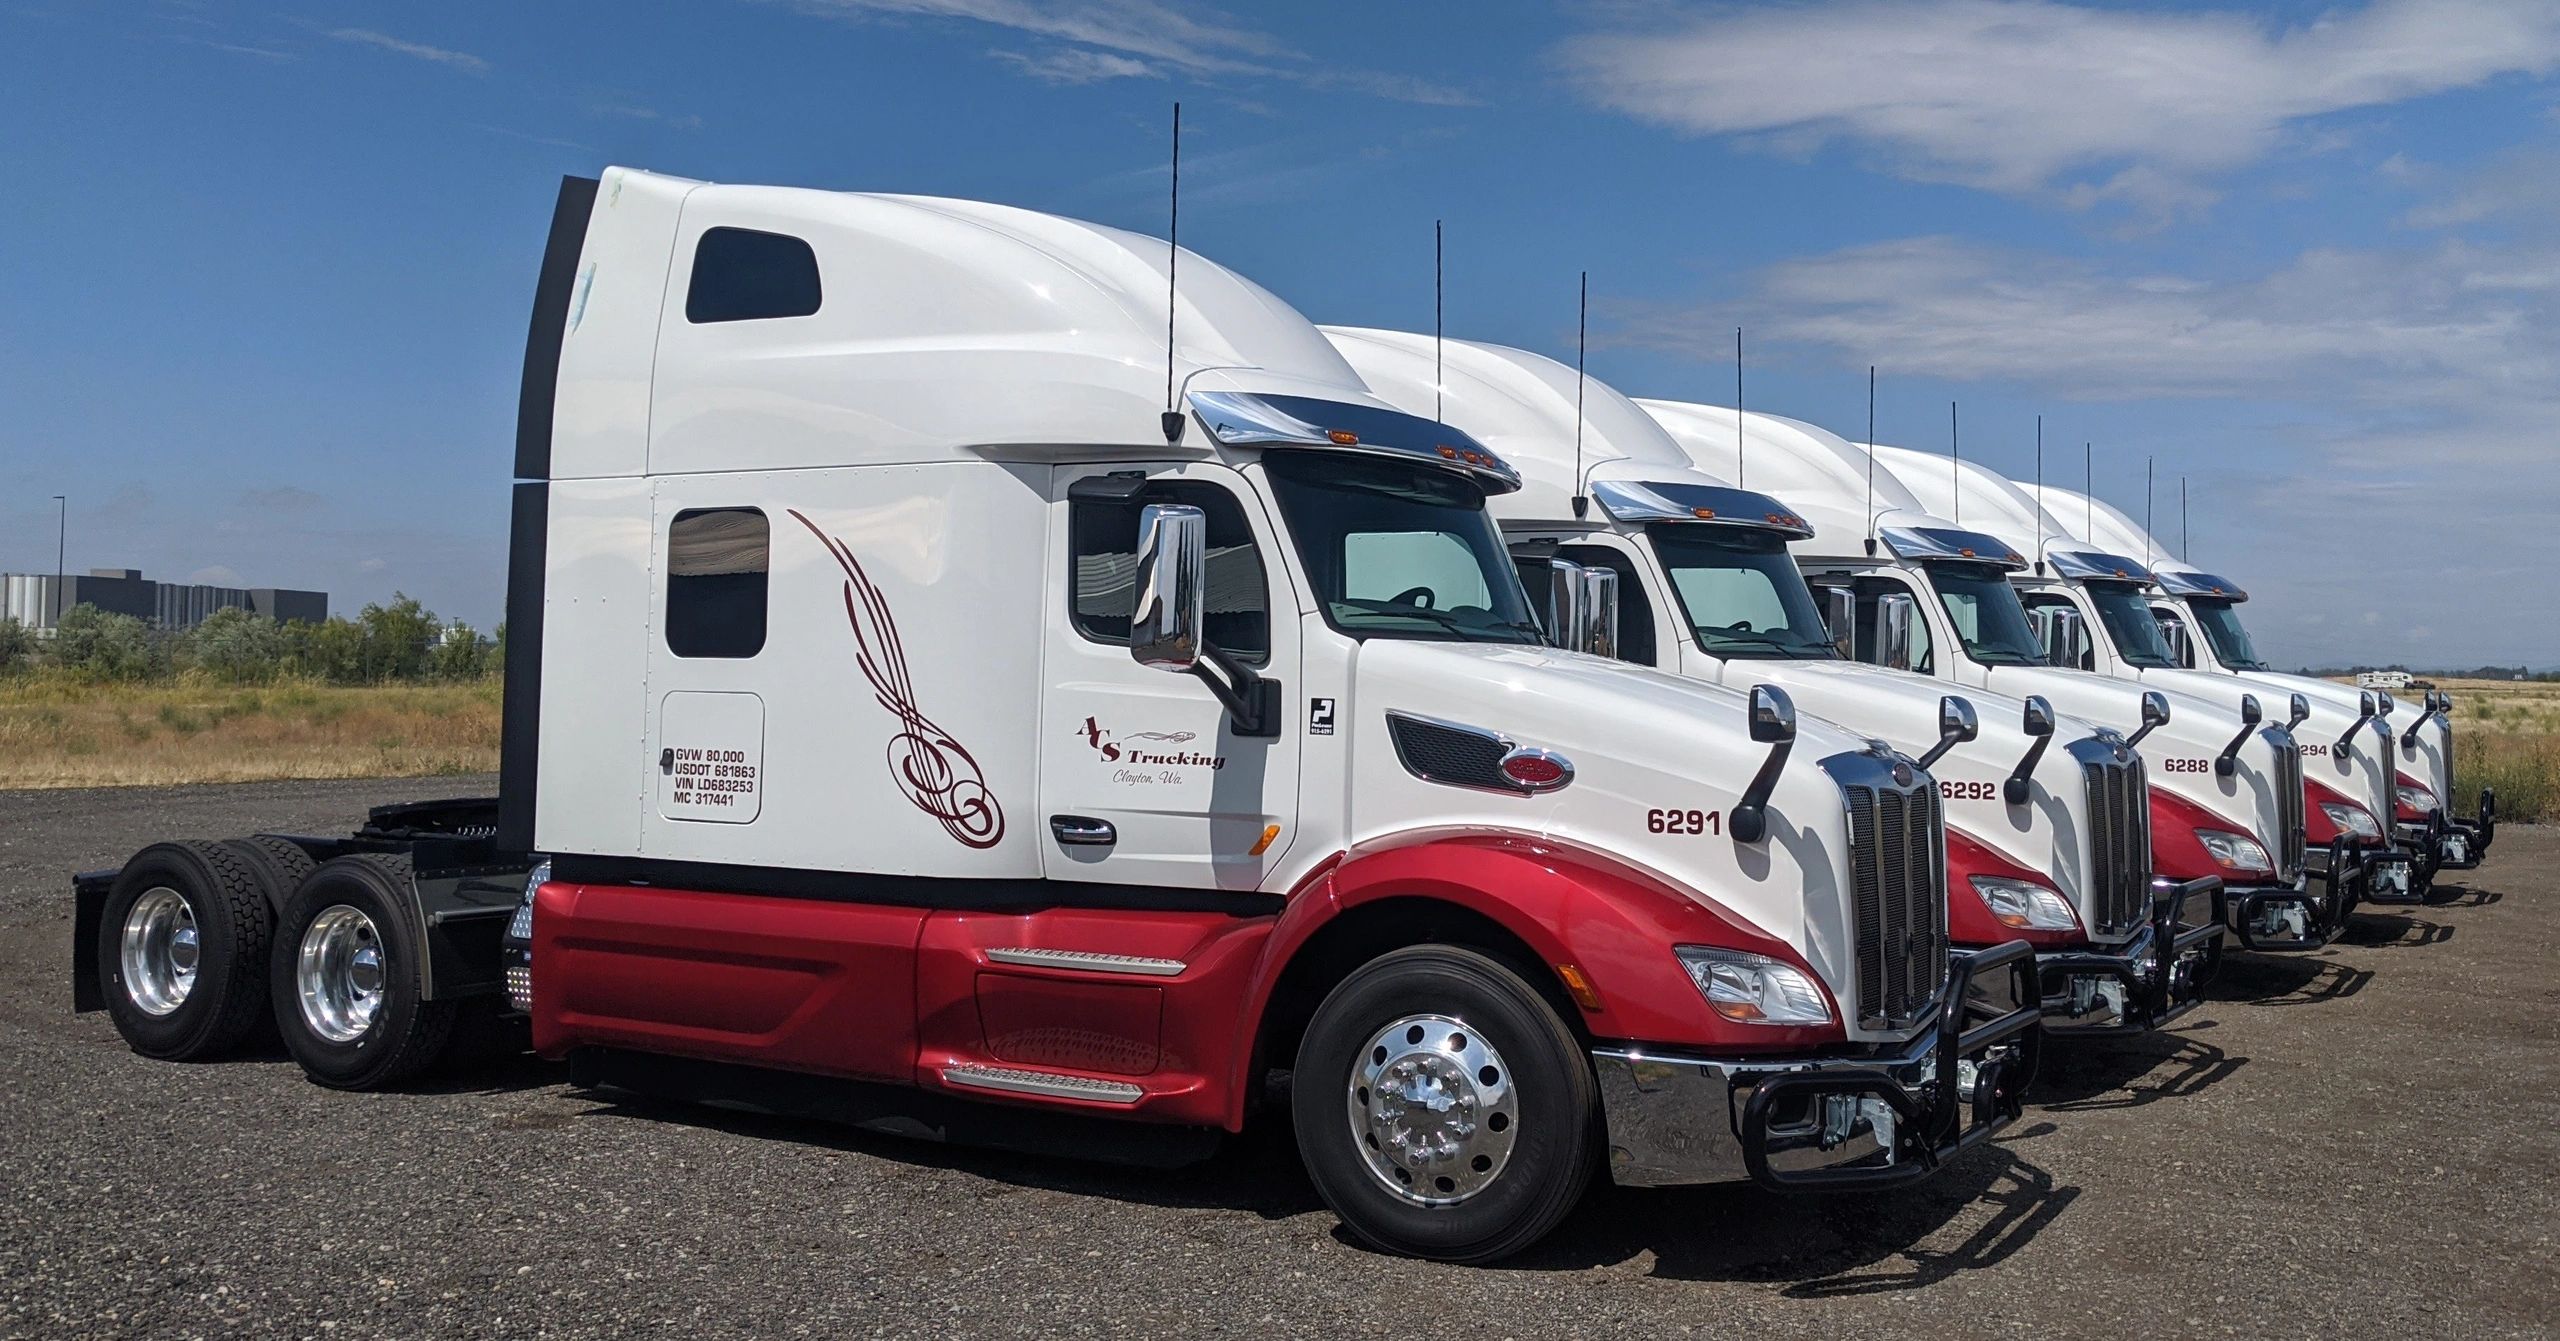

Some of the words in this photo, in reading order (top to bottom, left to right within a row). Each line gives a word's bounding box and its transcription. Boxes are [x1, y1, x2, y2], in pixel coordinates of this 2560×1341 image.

[675, 748, 702, 761] GVW
[706, 750, 745, 764] 80,000
[2300, 744, 2327, 756] 294
[1128, 750, 1226, 770] Trucking
[2165, 759, 2208, 773] 6288
[675, 762, 711, 776] USDOT
[714, 765, 755, 778] 681863
[675, 777, 694, 790] VIN
[698, 778, 754, 793] LD683253
[1940, 781, 1996, 800] 6292
[673, 791, 691, 804] MC
[695, 793, 734, 807] 317441
[1647, 809, 1720, 835] 6291
